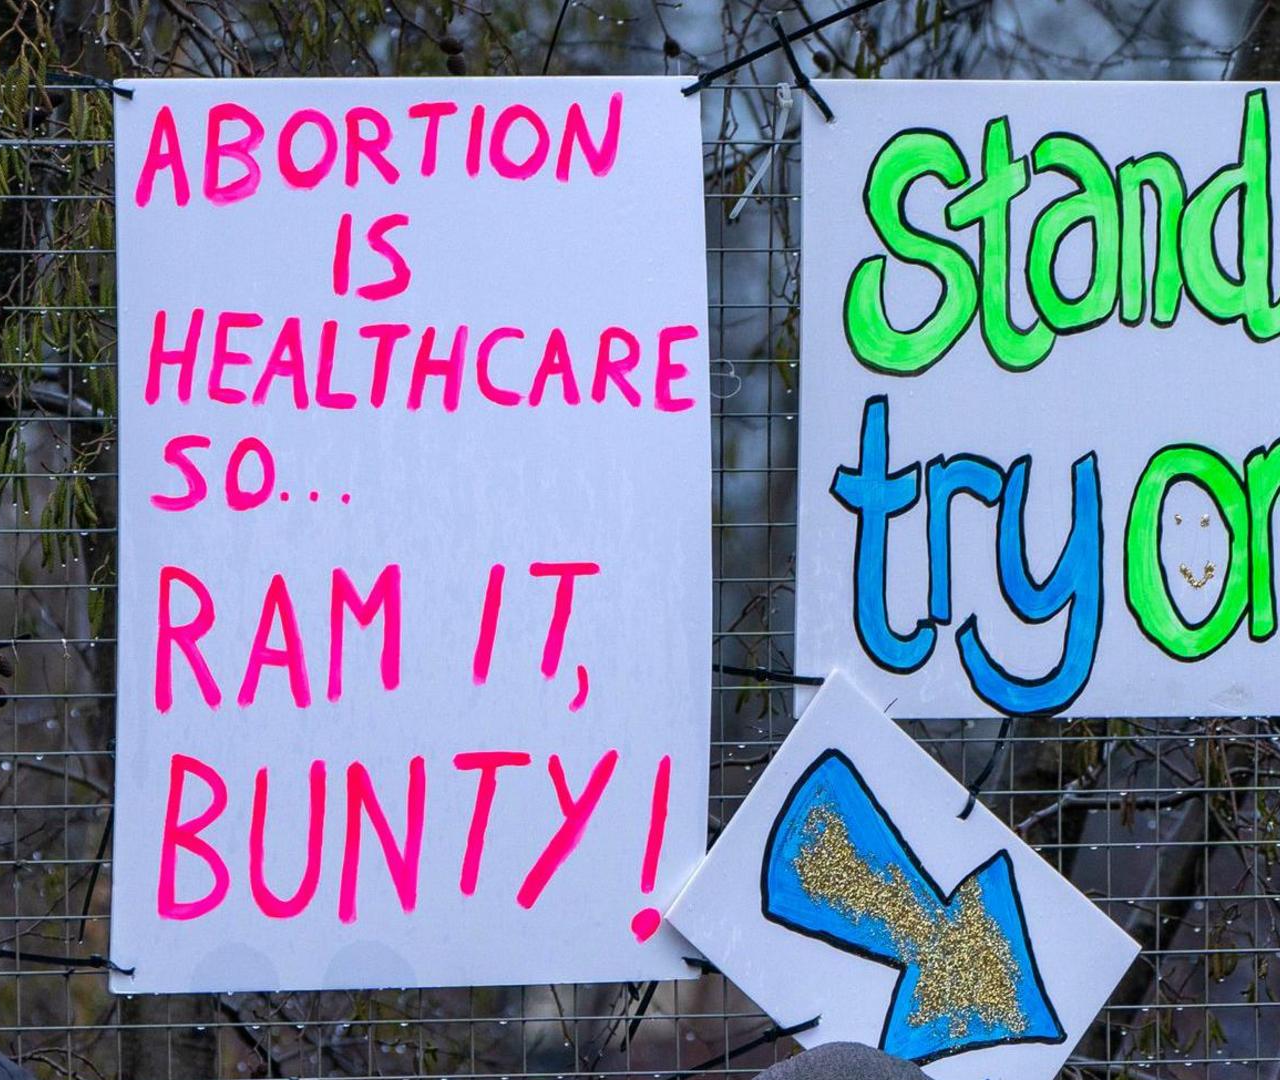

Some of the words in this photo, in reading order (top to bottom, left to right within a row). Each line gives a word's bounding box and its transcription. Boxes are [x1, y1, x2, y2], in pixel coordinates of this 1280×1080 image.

[136, 92, 622, 207] ABORTION
[333, 213, 411, 301] IS
[144, 308, 700, 412] HEALTHCARE
[151, 434, 352, 511] SO...
[831, 394, 1105, 717] try
[155, 563, 402, 714] RAM
[474, 562, 600, 711] IT,
[157, 749, 672, 943] BUNTY!
